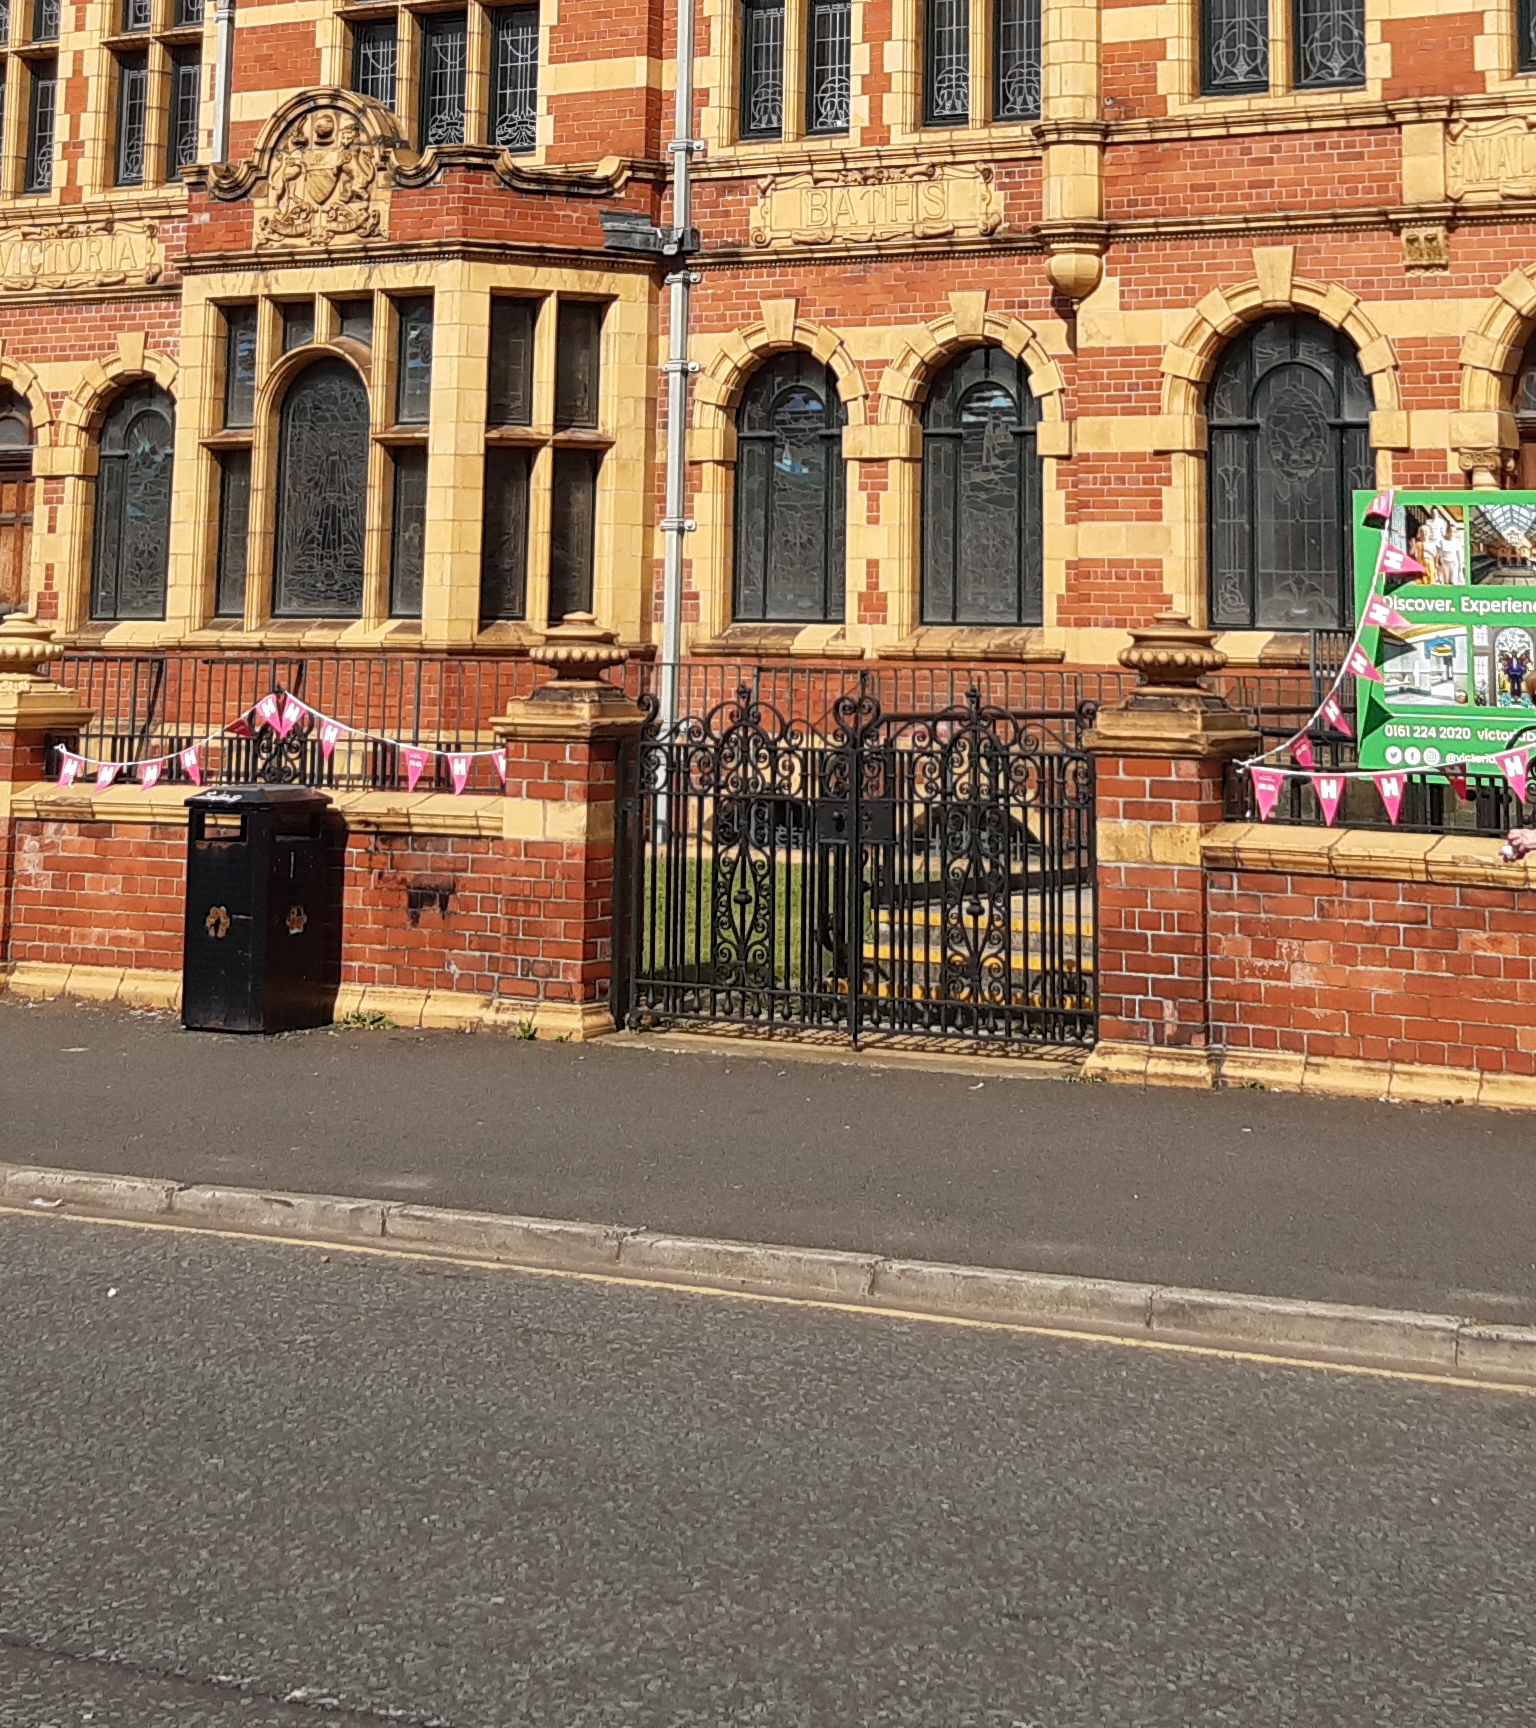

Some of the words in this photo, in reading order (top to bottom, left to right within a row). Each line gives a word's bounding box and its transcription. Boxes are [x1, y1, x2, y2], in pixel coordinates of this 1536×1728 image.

[806, 181, 947, 227] BATHS
[1384, 550, 1404, 570] H
[1369, 603, 1390, 624] H
[1351, 653, 1368, 674] H
[261, 698, 276, 718] H
[284, 703, 300, 722] H
[1325, 699, 1340, 721] H
[324, 725, 338, 743] H
[1384, 724, 1410, 738] 0161
[1414, 725, 1436, 738] 224
[1439, 726, 1471, 739] 2020
[64, 759, 78, 776] H
[184, 749, 197, 767] H
[453, 759, 466, 775] H
[1504, 756, 1524, 777] H
[100, 766, 114, 782] H
[145, 765, 158, 782] H
[1320, 779, 1337, 799] H
[1381, 778, 1399, 797] H
